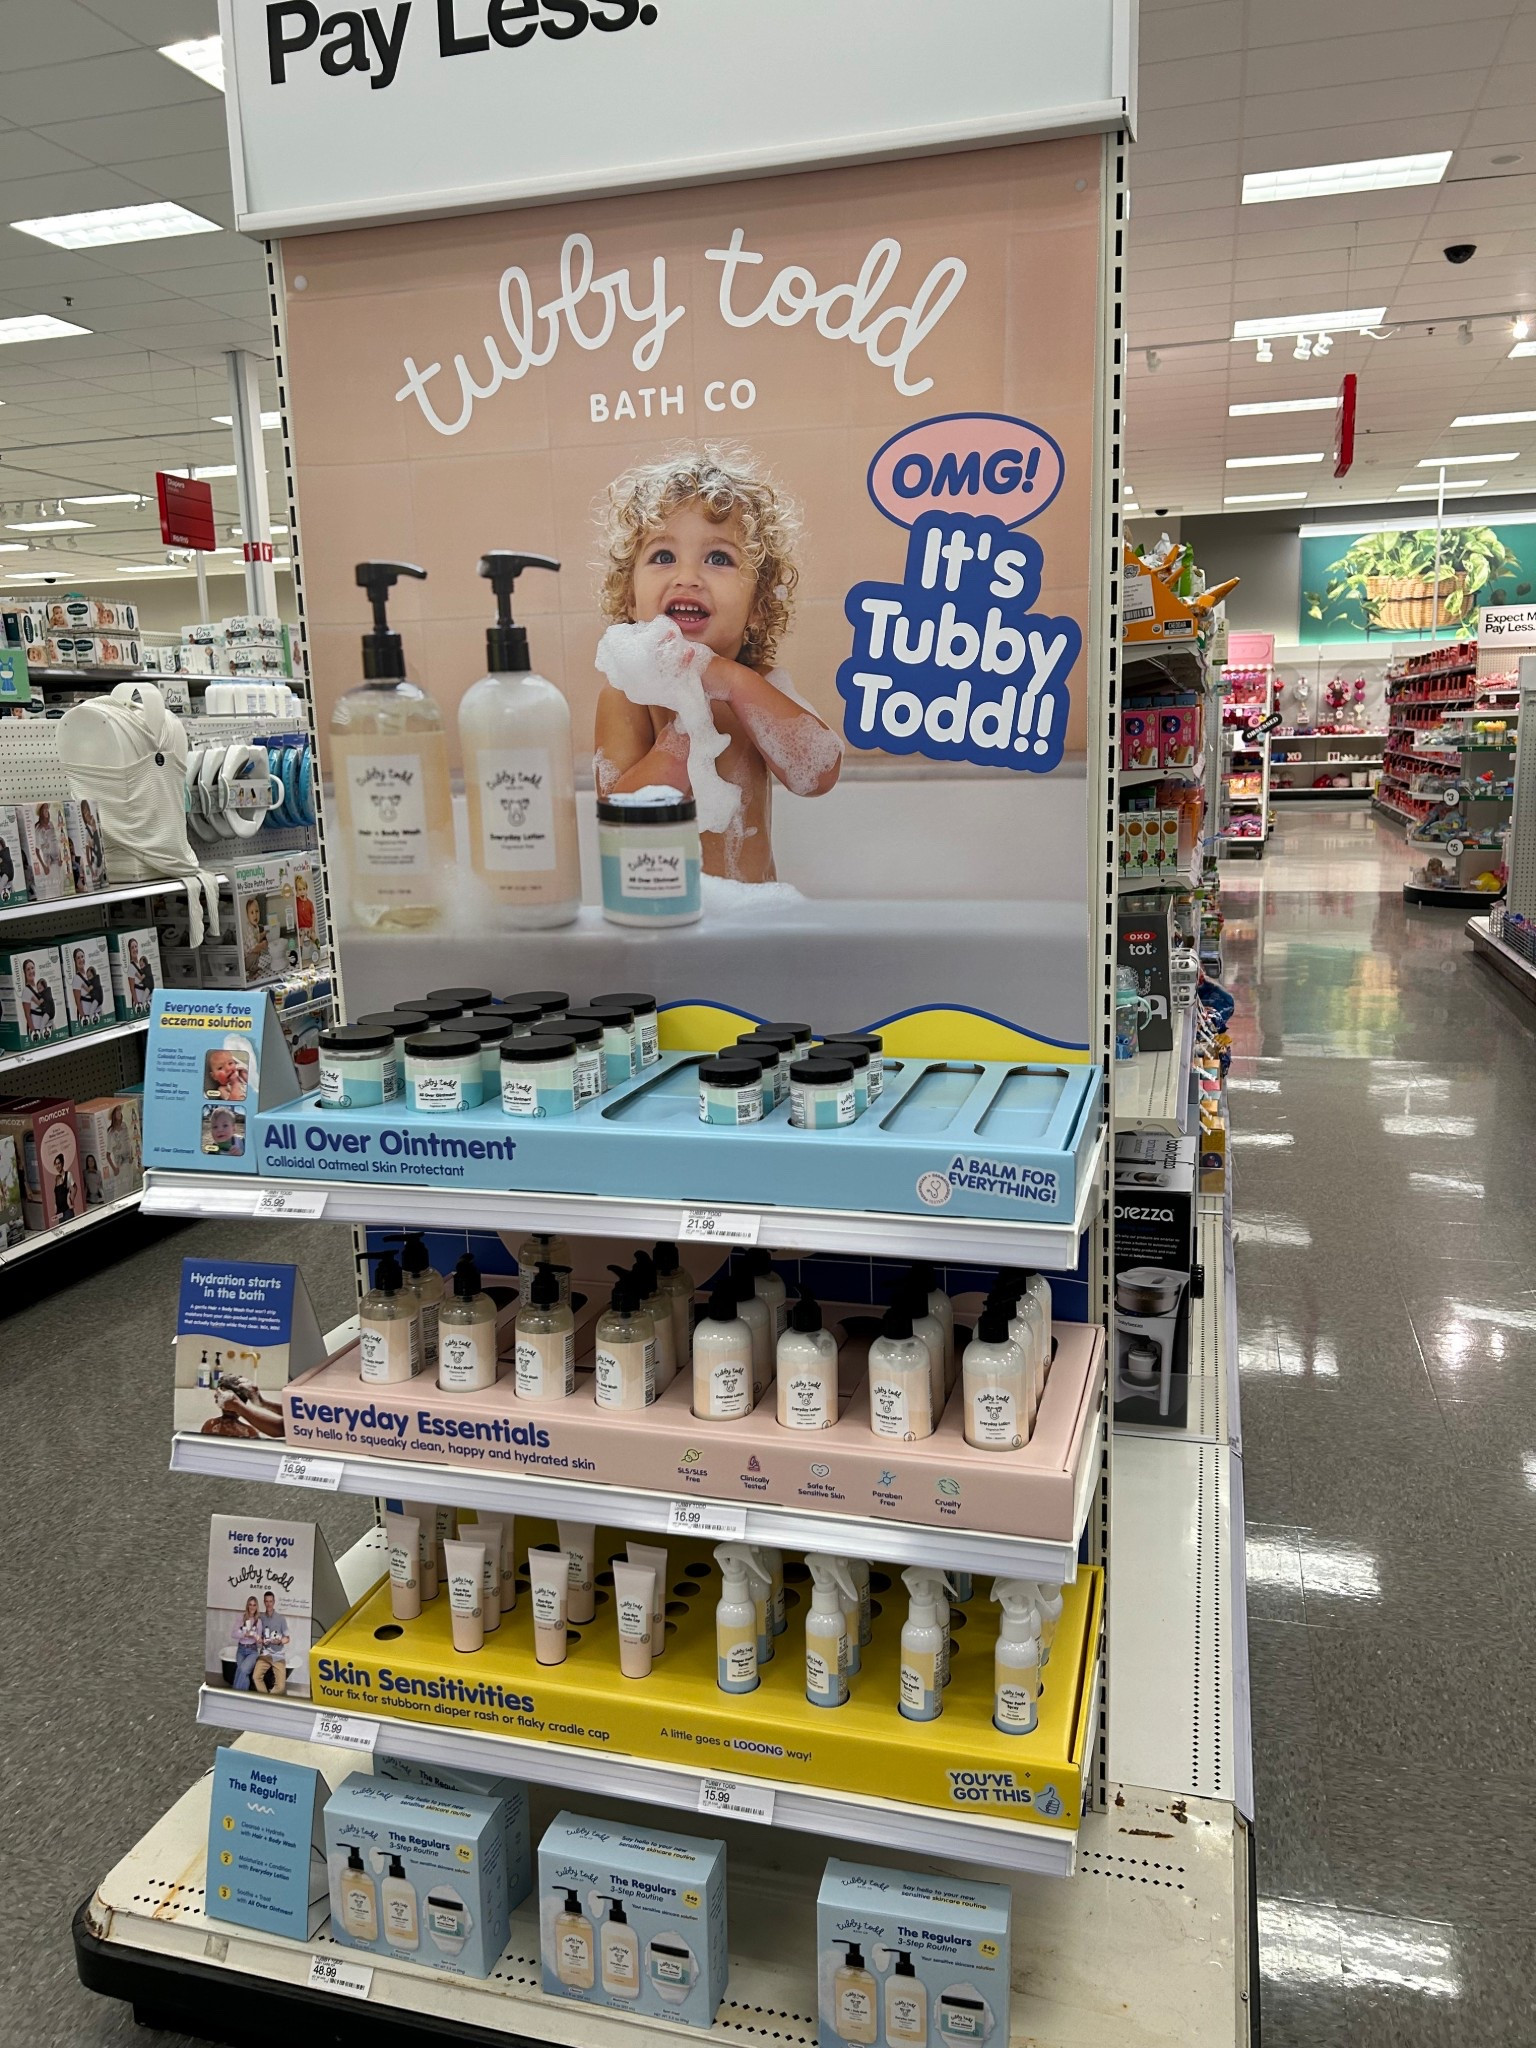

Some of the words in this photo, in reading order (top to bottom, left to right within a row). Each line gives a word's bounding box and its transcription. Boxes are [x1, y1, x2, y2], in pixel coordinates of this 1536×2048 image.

[267, 4, 406, 90] Pay
[437, 0, 658, 57] Less.
[395, 232, 685, 436] tubby
[705, 228, 966, 396] todd
[590, 387, 684, 423] BATH
[705, 379, 757, 412] CO
[891, 446, 1041, 498] OMG!
[920, 526, 1025, 599] It's
[1486, 613, 1523, 624] Expect
[1485, 623, 1505, 634] Pay
[1508, 623, 1535, 632] Less.
[861, 598, 1067, 692] Tubby
[852, 673, 1056, 754] Todd!!
[1246, 716, 1279, 739] OBSESSED
[1286, 752, 1302, 762] XO
[236, 866, 265, 880] ingenuity
[244, 881, 253, 889] Size
[254, 880, 265, 888] Potty
[1129, 943, 1152, 955] tot
[164, 1001, 223, 1015] Everyone's
[226, 1002, 251, 1014] fave
[161, 1016, 204, 1027] eczema
[207, 1016, 252, 1029] solution
[264, 1124, 297, 1150] All
[305, 1126, 371, 1154] Over
[380, 1129, 517, 1160] Ointment
[266, 1155, 315, 1169] Colloidal
[318, 1158, 369, 1172] Oatmeal
[372, 1161, 397, 1173] Skin
[400, 1162, 465, 1177] Protectant
[952, 1157, 964, 1171] A
[969, 1160, 1017, 1180] BALM
[1022, 1169, 1056, 1187] FOR
[949, 1172, 1057, 1203] EVERYTHING!
[261, 1198, 285, 1207] 35.99
[687, 1219, 715, 1229] 21.99
[190, 1272, 245, 1286] Hydration
[248, 1277, 281, 1289] starts
[204, 1286, 214, 1297] in
[217, 1287, 236, 1299] the
[239, 1288, 265, 1301] bath
[290, 1396, 409, 1437] Everyday
[418, 1410, 550, 1448] Essentials
[293, 1424, 313, 1440] Say
[316, 1428, 342, 1441] hello
[345, 1430, 357, 1442] to
[360, 1435, 407, 1450] squeaky
[410, 1439, 446, 1454] clean,
[448, 1442, 484, 1458] happy
[488, 1447, 511, 1460] and
[514, 1449, 569, 1468] hydrated
[572, 1455, 596, 1470] skin
[284, 1464, 306, 1474] 16.99
[678, 1467, 708, 1476] SLS/SLES
[740, 1474, 769, 1484] Clinically
[744, 1482, 766, 1490] Tested
[807, 1482, 823, 1490] Safe
[798, 1488, 829, 1498] Sensitive
[831, 1492, 845, 1500] Skin
[872, 1490, 903, 1500] Paraben
[935, 1499, 962, 1509] Cruelty
[941, 1507, 956, 1515] Free
[675, 1511, 701, 1522] 16.99
[228, 1530, 254, 1542] Here
[257, 1532, 272, 1543] for
[275, 1536, 294, 1547] you
[233, 1544, 260, 1556] since
[263, 1547, 288, 1558] 2014
[227, 1564, 263, 1587] tubby
[266, 1568, 294, 1592] todd
[318, 1659, 371, 1687] Skin
[379, 1669, 535, 1713] Sensitivities
[319, 1685, 343, 1698] Your
[346, 1689, 360, 1701] fix
[362, 1692, 378, 1704] for
[381, 1695, 431, 1711] stubborn
[434, 1703, 471, 1720] diaper
[474, 1708, 499, 1722] rash
[502, 1714, 515, 1724] or
[517, 1715, 545, 1731] flaky
[548, 1720, 585, 1737] cradle
[588, 1727, 610, 1741] cap
[320, 1722, 342, 1733] 15.99
[661, 1728, 668, 1737] A
[671, 1729, 692, 1740] little
[695, 1735, 720, 1745] goes
[734, 1740, 783, 1756] LOOONG
[787, 1750, 812, 1761] way!
[250, 1770, 277, 1785] Meet
[950, 1772, 1013, 1787] YOU'VE
[229, 1778, 247, 1792] The
[250, 1785, 297, 1804] Regulars!
[704, 1790, 730, 1802] 15.99
[953, 1787, 989, 1800] GOT
[992, 1788, 1031, 1803] THIS
[241, 1821, 260, 1831] Cleanse
[266, 1827, 285, 1837] Hydrate
[241, 1830, 251, 1838] with
[268, 1837, 281, 1846] Body
[282, 1840, 296, 1848] Wash
[239, 1855, 263, 1866] Moisturize
[269, 1863, 292, 1872] Condition
[238, 1864, 249, 1872] with
[249, 1866, 273, 1877] Everyday
[274, 1873, 289, 1881] Lotion
[841, 1876, 867, 1887] tubby
[869, 1879, 890, 1892] todd
[222, 1889, 227, 1897] 3
[237, 1888, 253, 1898] Soothe
[259, 1894, 271, 1902] Treat
[901, 1891, 930, 1900] sensitive
[932, 1895, 960, 1905] skincare
[962, 1900, 986, 1909] routine
[916, 1886, 933, 1894] hello
[943, 1891, 959, 1899] your
[256, 1902, 267, 1910] Over
[269, 1905, 293, 1916] Ointment
[836, 1919, 862, 1931] tubby
[864, 1921, 884, 1937] todd
[898, 1926, 919, 1938] The
[922, 1930, 972, 1947] Regulars
[898, 1938, 924, 1948] 3-Step
[927, 1942, 957, 1953] Routine
[313, 1965, 337, 1977] 48.99
